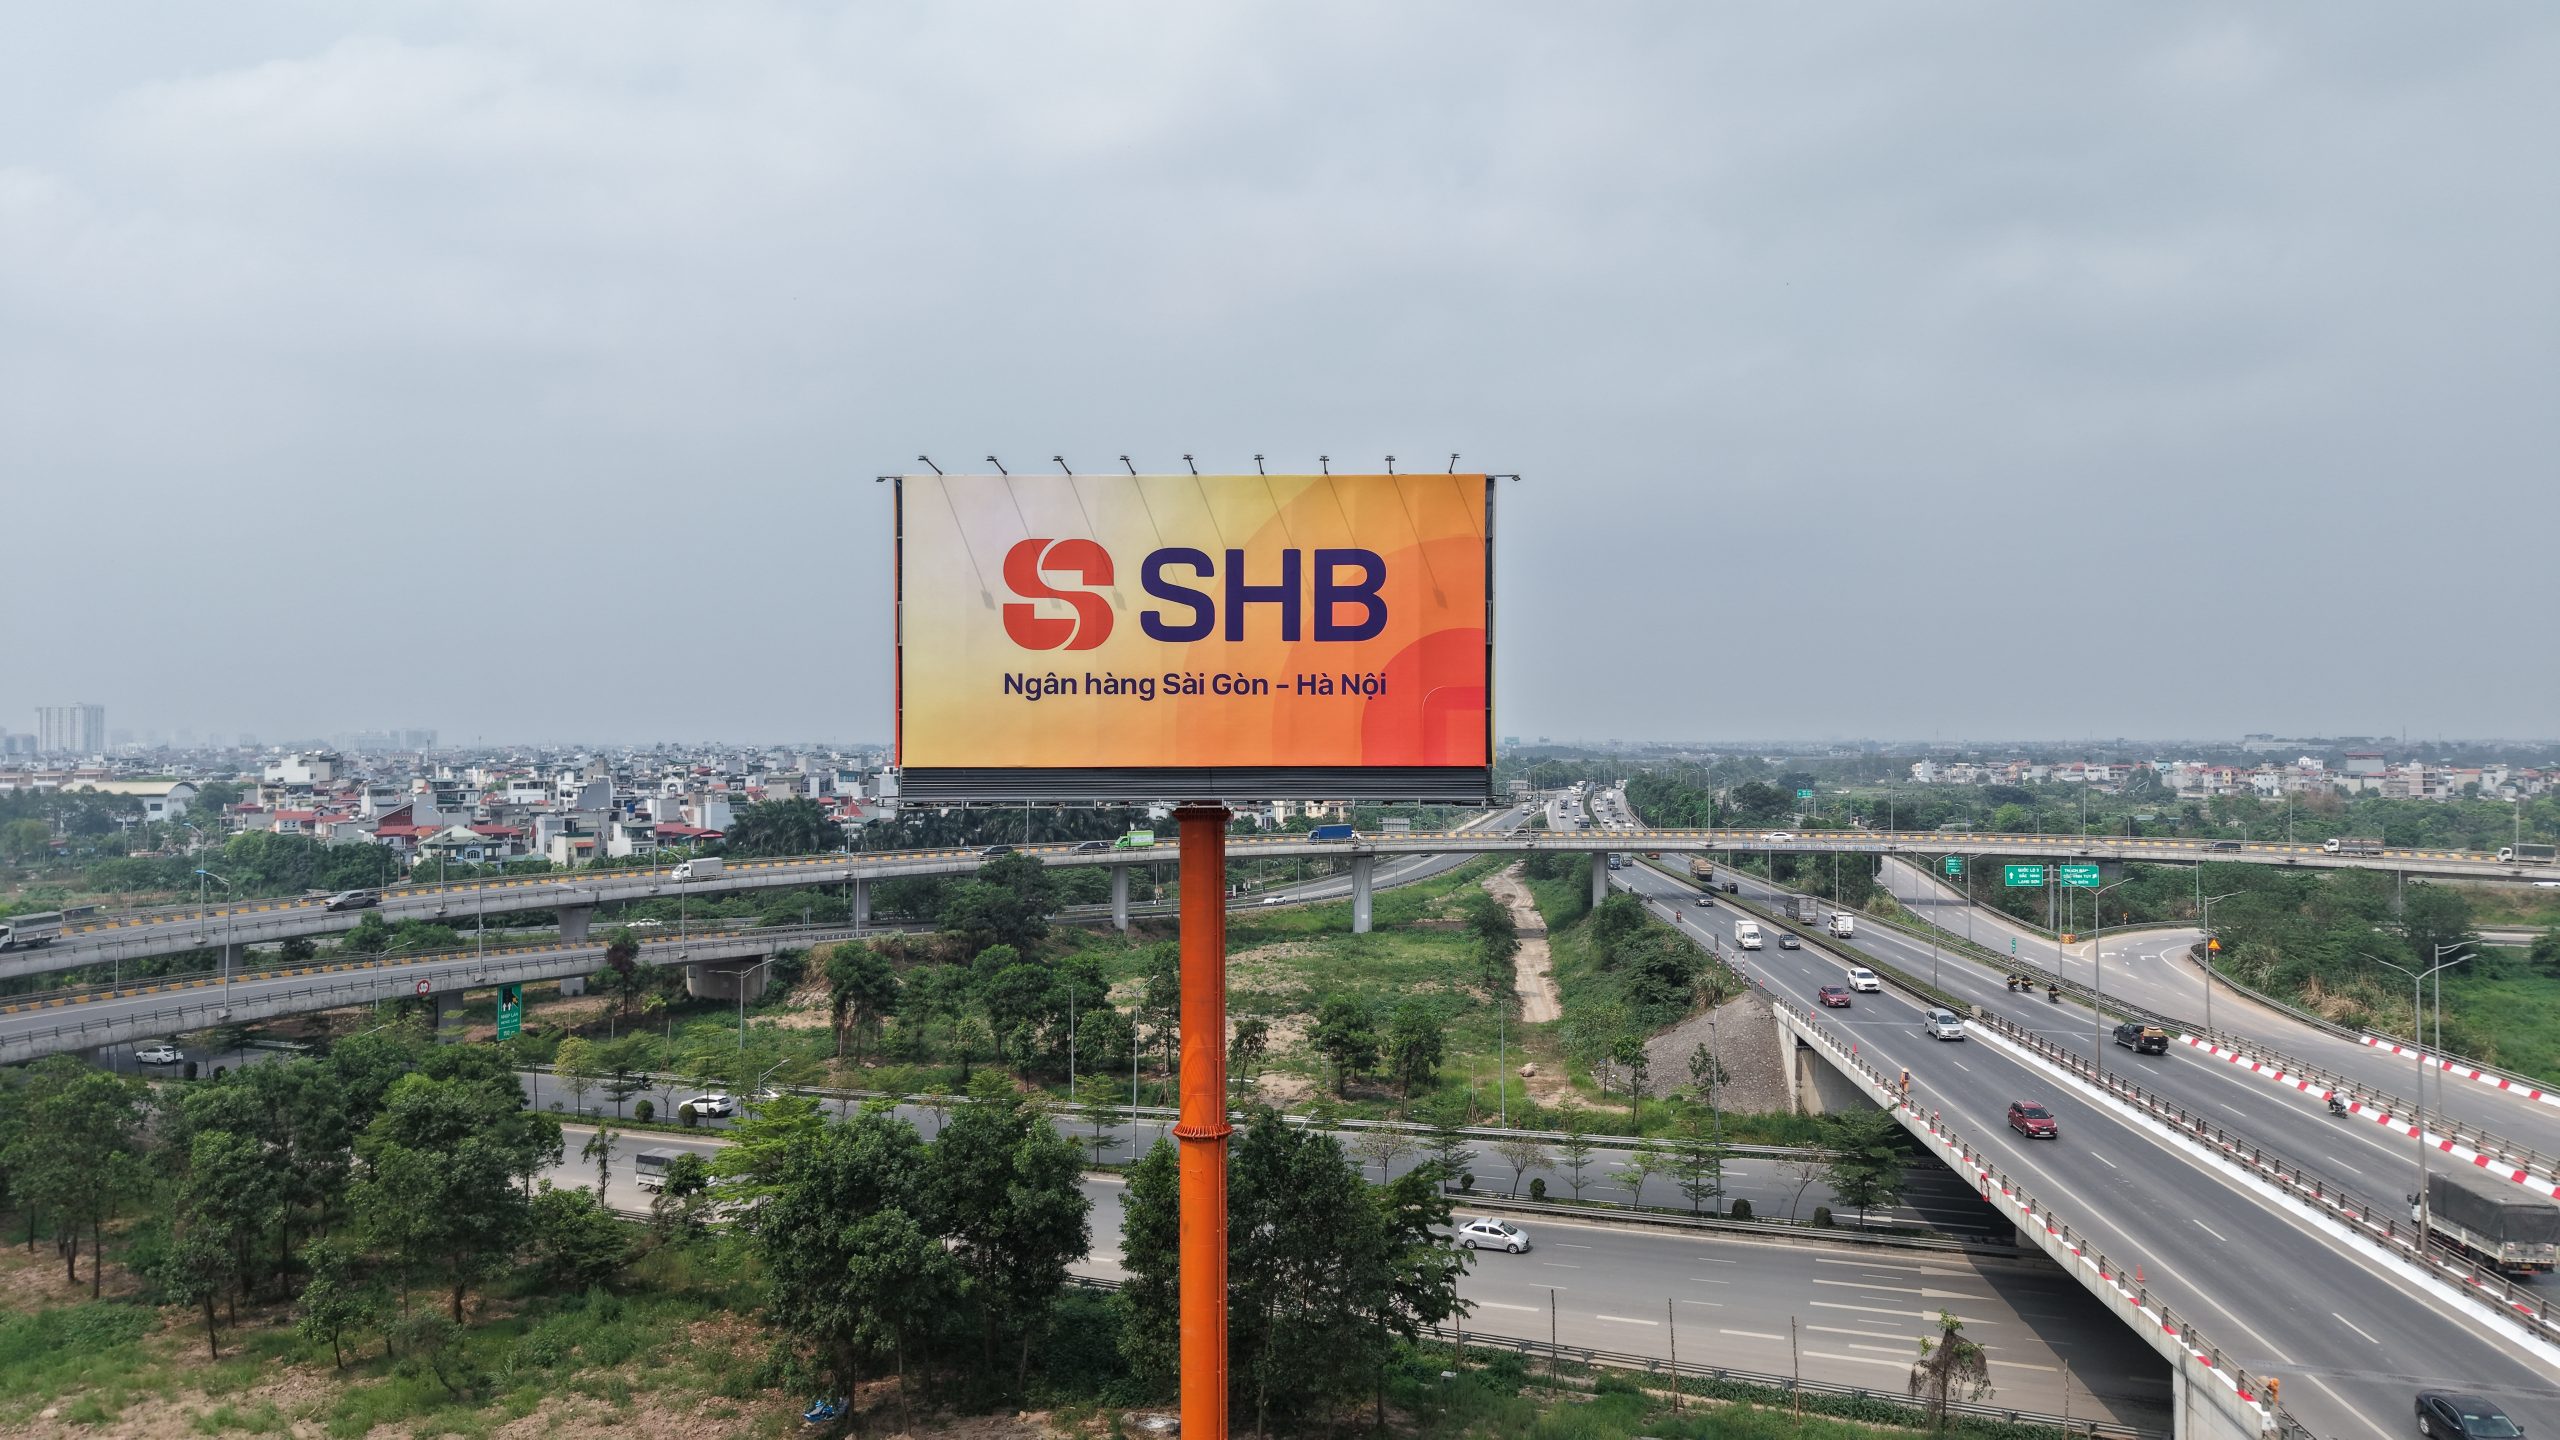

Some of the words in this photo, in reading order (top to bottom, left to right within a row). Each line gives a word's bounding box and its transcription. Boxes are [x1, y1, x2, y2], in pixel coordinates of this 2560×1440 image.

[1141, 548, 1387, 642] SHB
[1005, 672, 1077, 701] Ngân
[1086, 672, 1154, 701] hàng
[1163, 672, 1204, 695] Sài
[1213, 672, 1268, 695] Gòn
[1298, 672, 1333, 695] Hà
[1342, 672, 1386, 700] Nội
